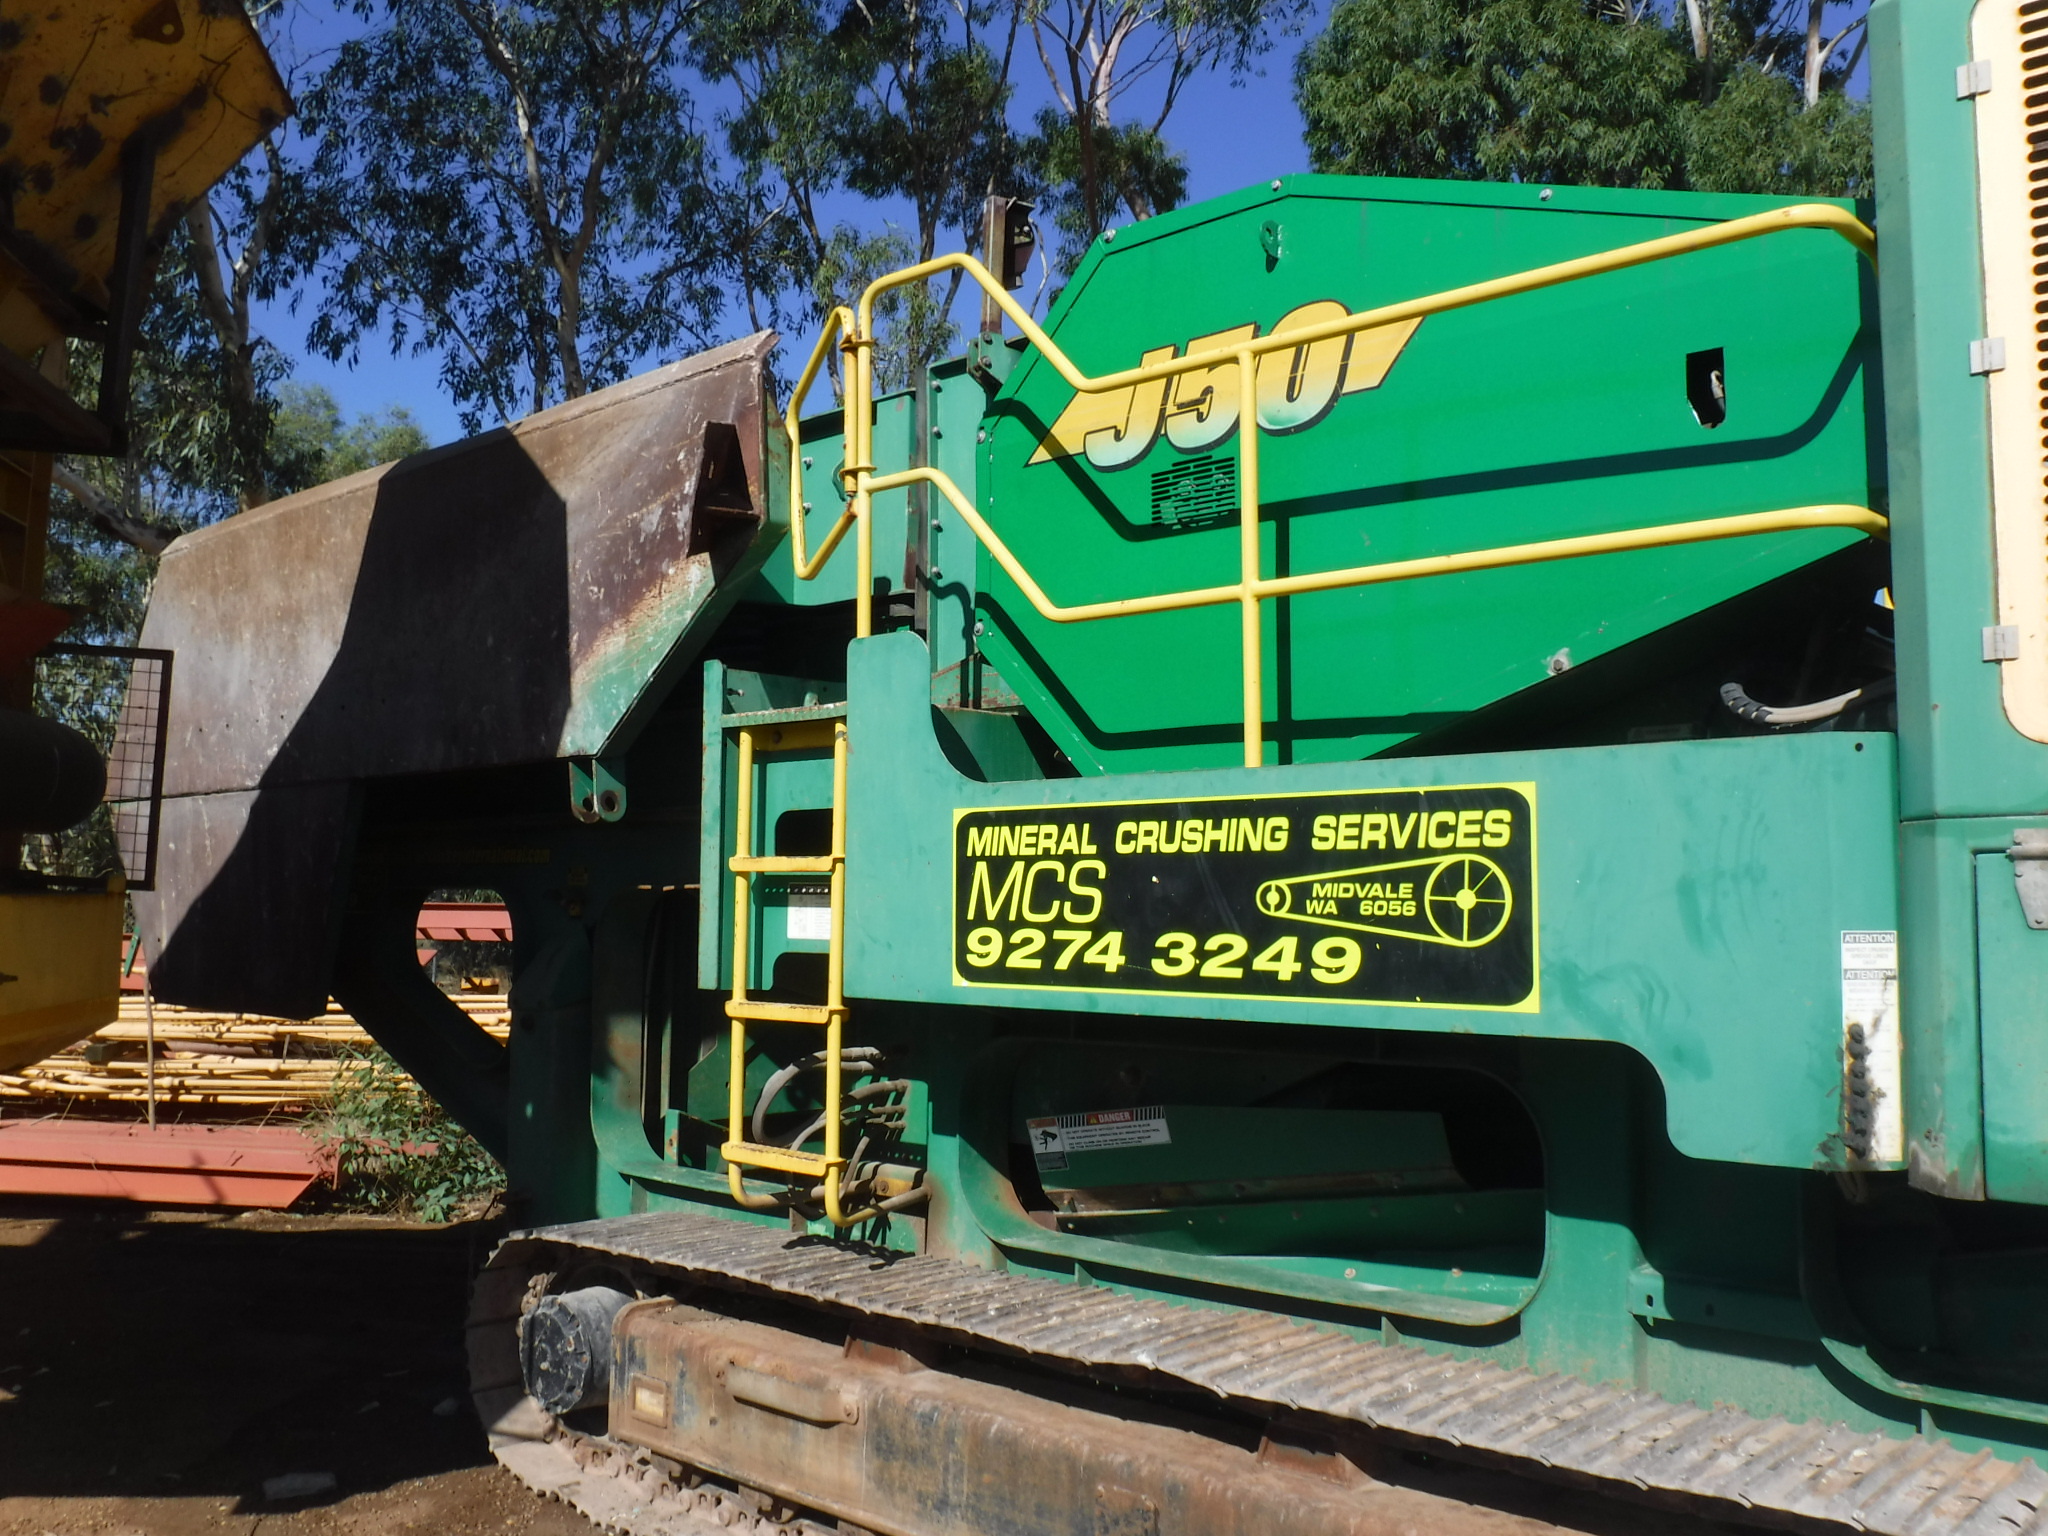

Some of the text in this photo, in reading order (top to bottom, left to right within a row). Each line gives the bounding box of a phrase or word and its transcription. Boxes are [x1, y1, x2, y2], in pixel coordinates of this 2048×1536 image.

[1083, 299, 1354, 473] J50
[966, 809, 1513, 857] MINERAL CRUSHING SERVICES
[966, 859, 1107, 924] MCS
[1311, 882, 1414, 899] MIDVALE
[1305, 899, 1417, 917] WA 6056
[1844, 933, 1894, 943] ATTENTION
[966, 926, 1362, 985] 9274 3249
[1097, 1110, 1131, 1123] DANGER
